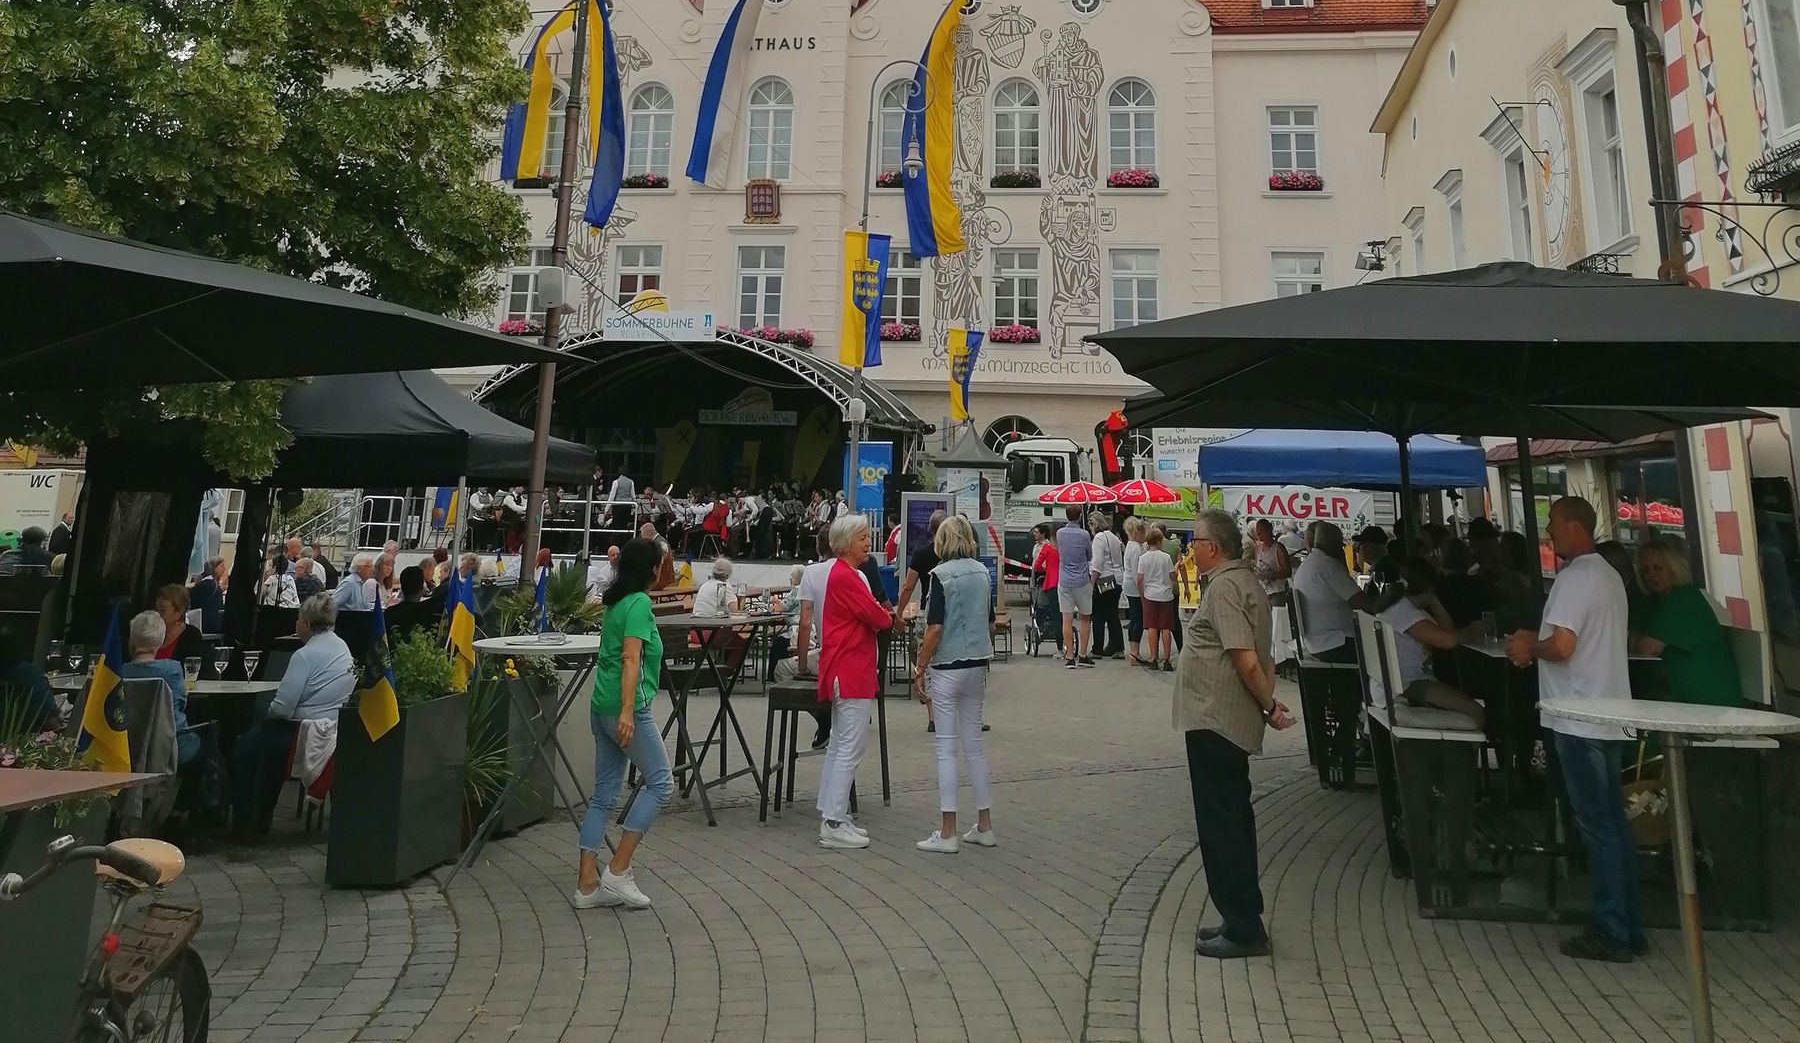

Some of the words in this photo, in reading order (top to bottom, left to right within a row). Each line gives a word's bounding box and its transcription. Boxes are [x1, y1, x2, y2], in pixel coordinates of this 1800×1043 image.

[749, 37, 816, 51] THAUS
[1083, 360, 1112, 374] 1136
[30, 474, 56, 488] WC
[1246, 492, 1350, 519] KAGER
